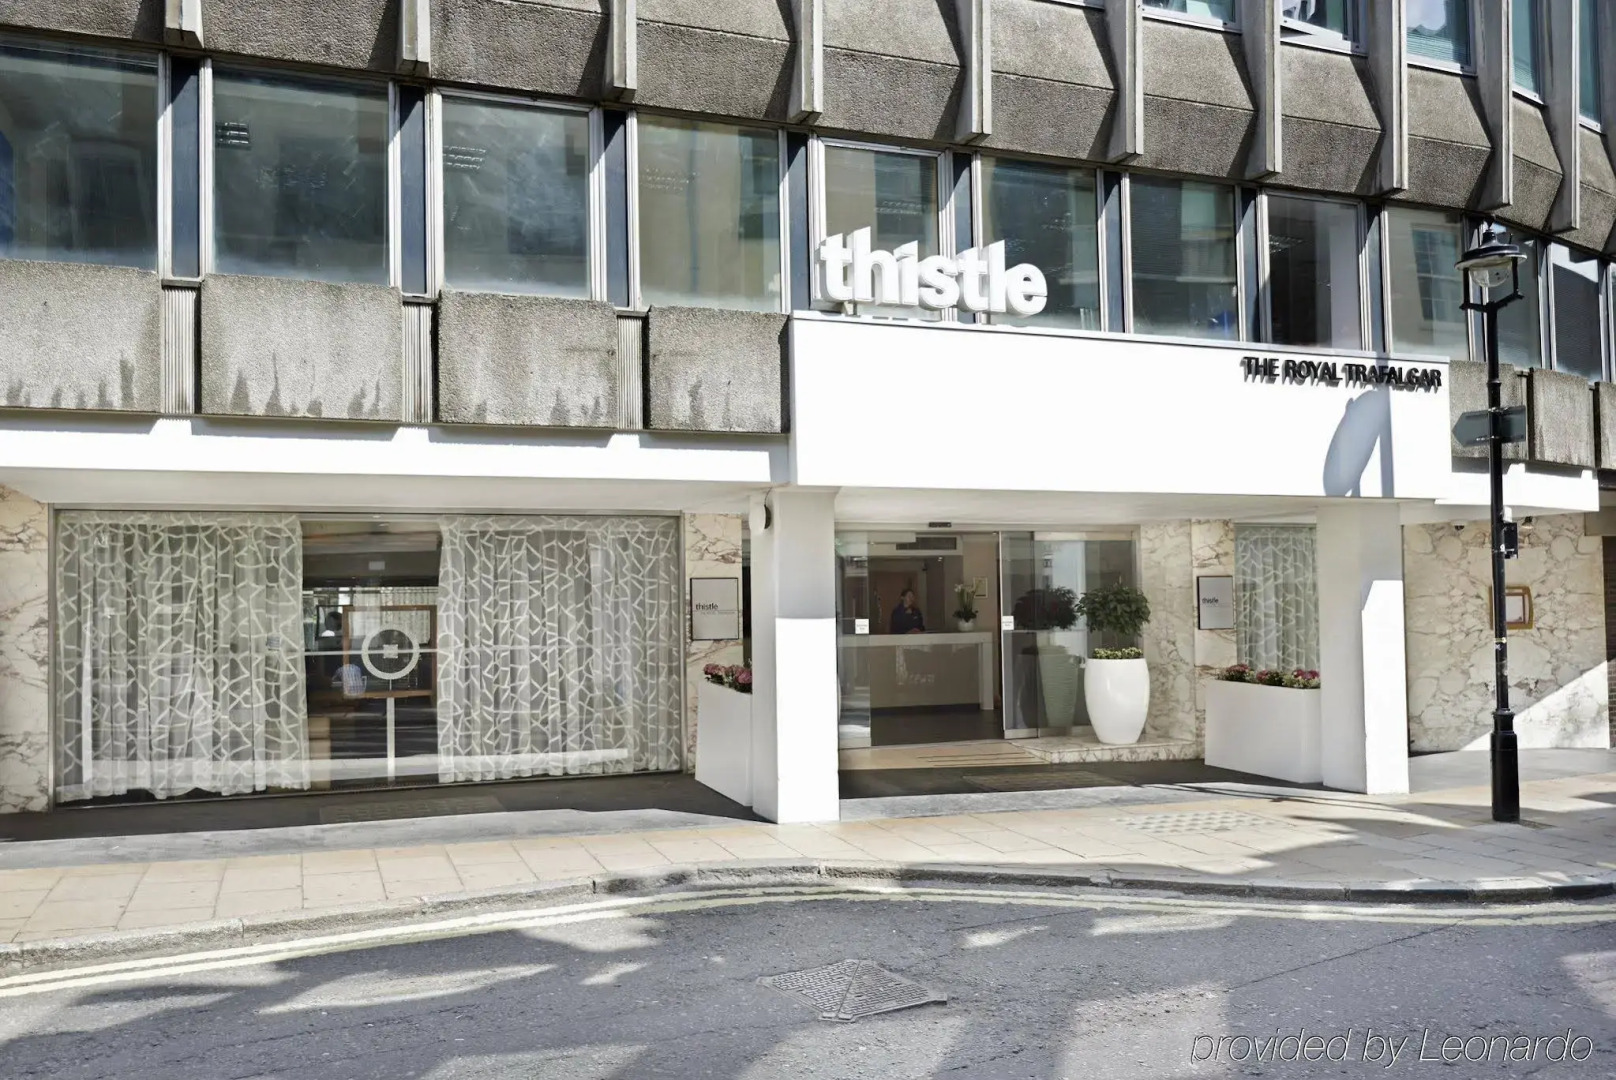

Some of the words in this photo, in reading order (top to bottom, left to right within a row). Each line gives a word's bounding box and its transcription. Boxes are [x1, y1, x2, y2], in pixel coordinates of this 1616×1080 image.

[817, 226, 1048, 318] thistle
[1241, 356, 1280, 381] THE
[1282, 359, 1342, 384] ROYAL
[1343, 363, 1442, 391] TRAFALGAR
[695, 602, 719, 611] thistle
